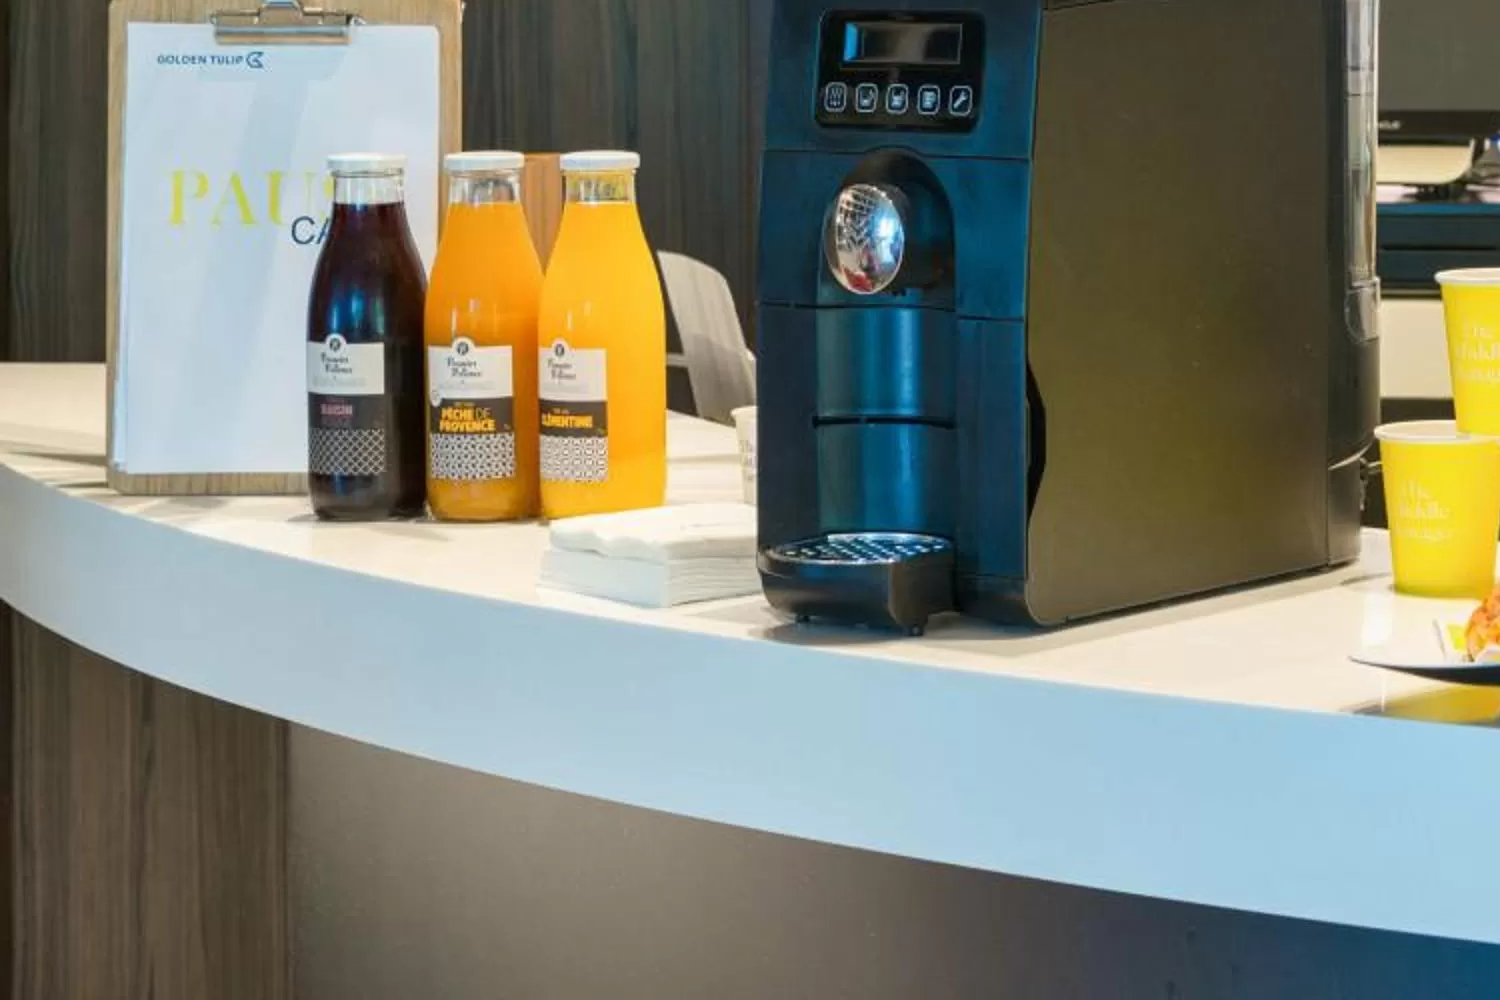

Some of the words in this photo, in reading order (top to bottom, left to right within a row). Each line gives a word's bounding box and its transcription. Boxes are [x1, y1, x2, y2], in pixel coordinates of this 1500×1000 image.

[157, 54, 207, 65] GOLDEN
[210, 54, 243, 65] TULIP
[439, 419, 496, 432] PROVENCE
